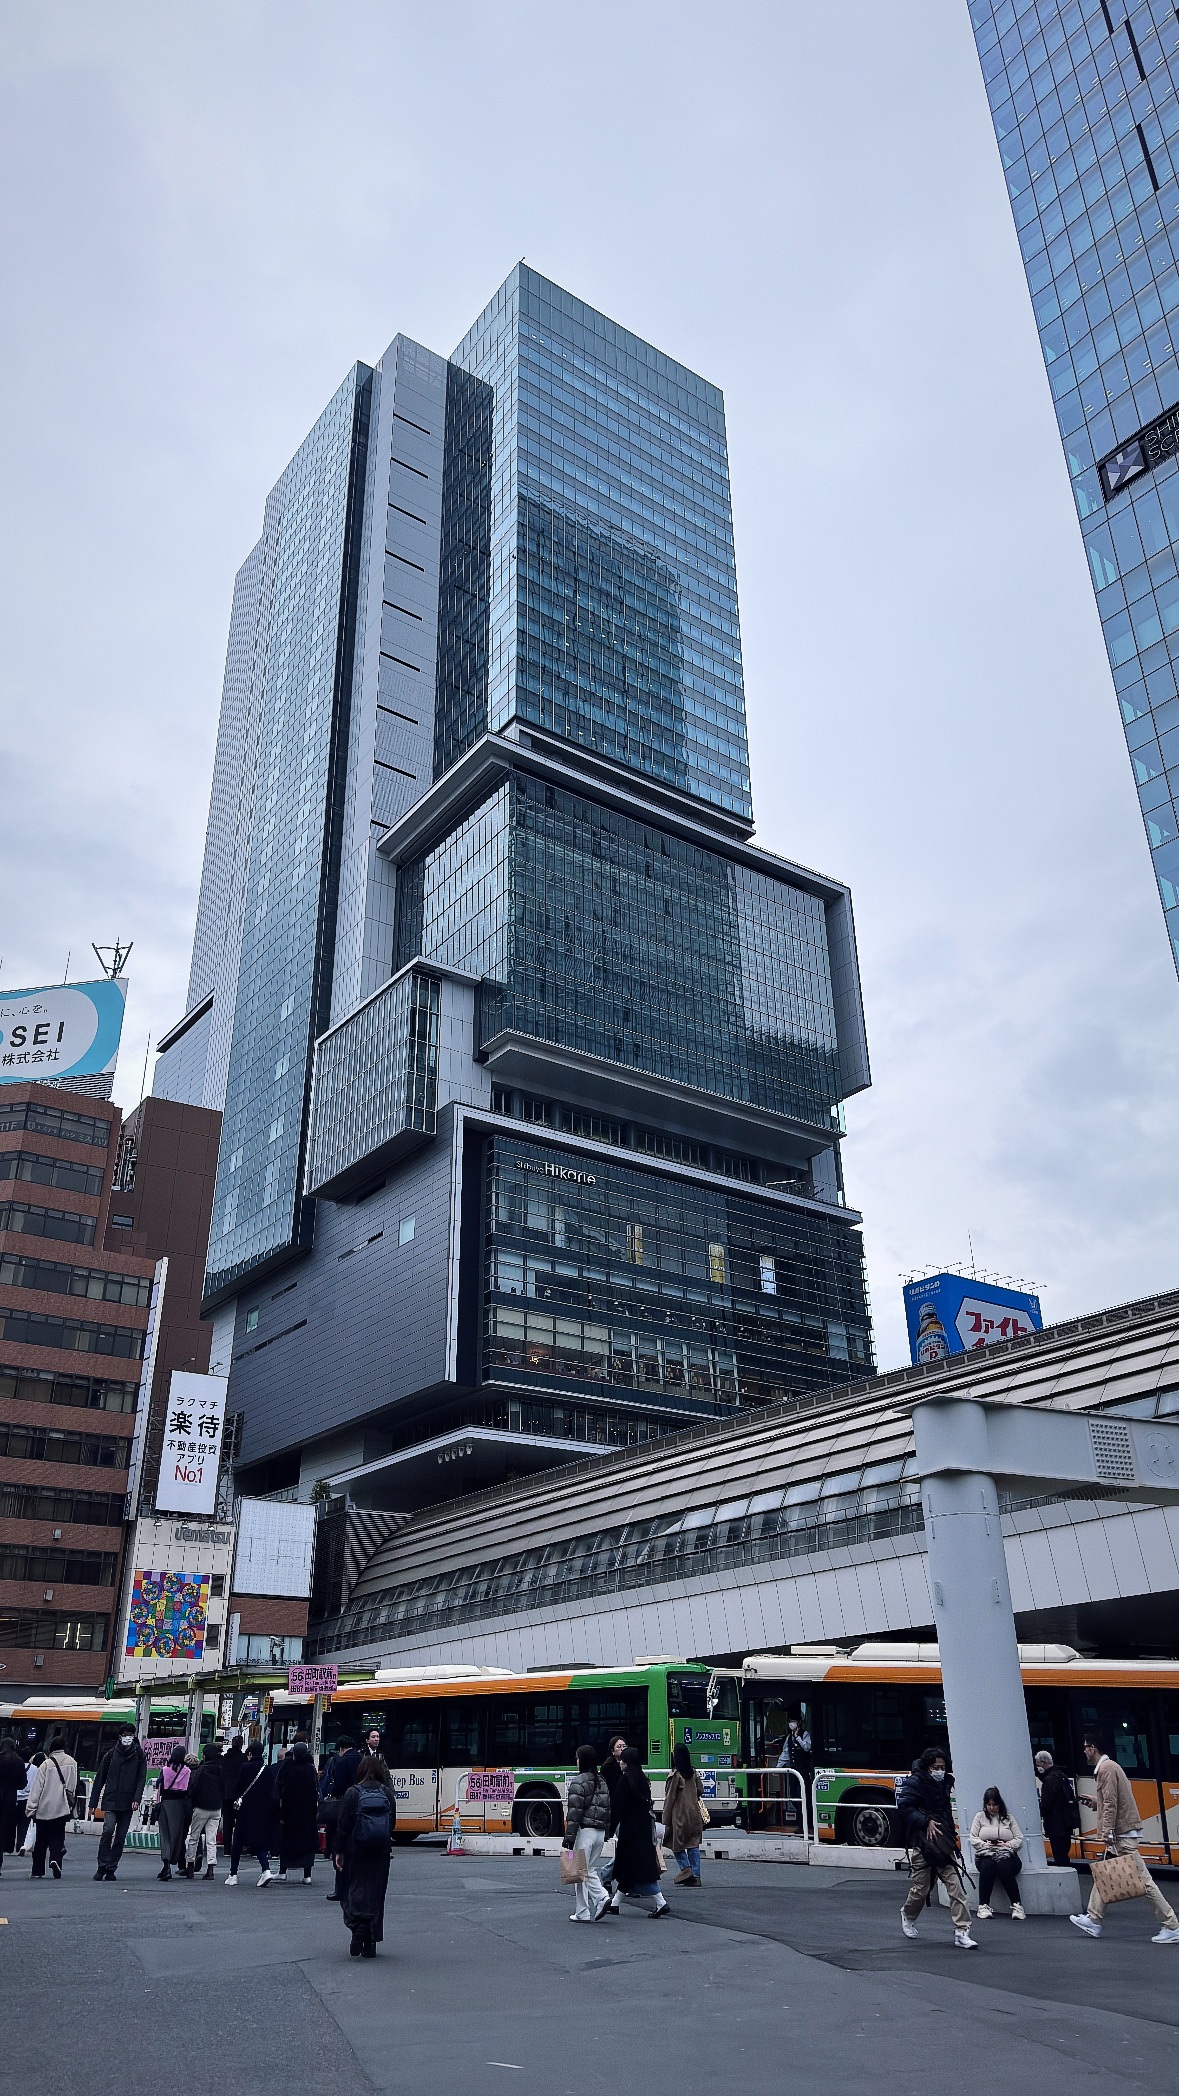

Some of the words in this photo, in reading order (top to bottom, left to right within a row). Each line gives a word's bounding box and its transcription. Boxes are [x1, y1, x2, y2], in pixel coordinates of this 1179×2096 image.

[1145, 411, 1179, 446] SHI
[2, 1047, 60, 1067] 株式会社
[544, 1162, 596, 1185] Hikarie
[966, 1311, 1028, 1337] ファイト
[176, 1397, 218, 1409] ラクマチ
[169, 1411, 220, 1438] 楽待
[167, 1440, 217, 1455] 不動産投資
[177, 1454, 205, 1465] アプリ
[175, 1465, 203, 1484] No.1
[292, 1671, 304, 1682] 56
[409, 1774, 425, 1786] Bus
[470, 1778, 480, 1789] 56
